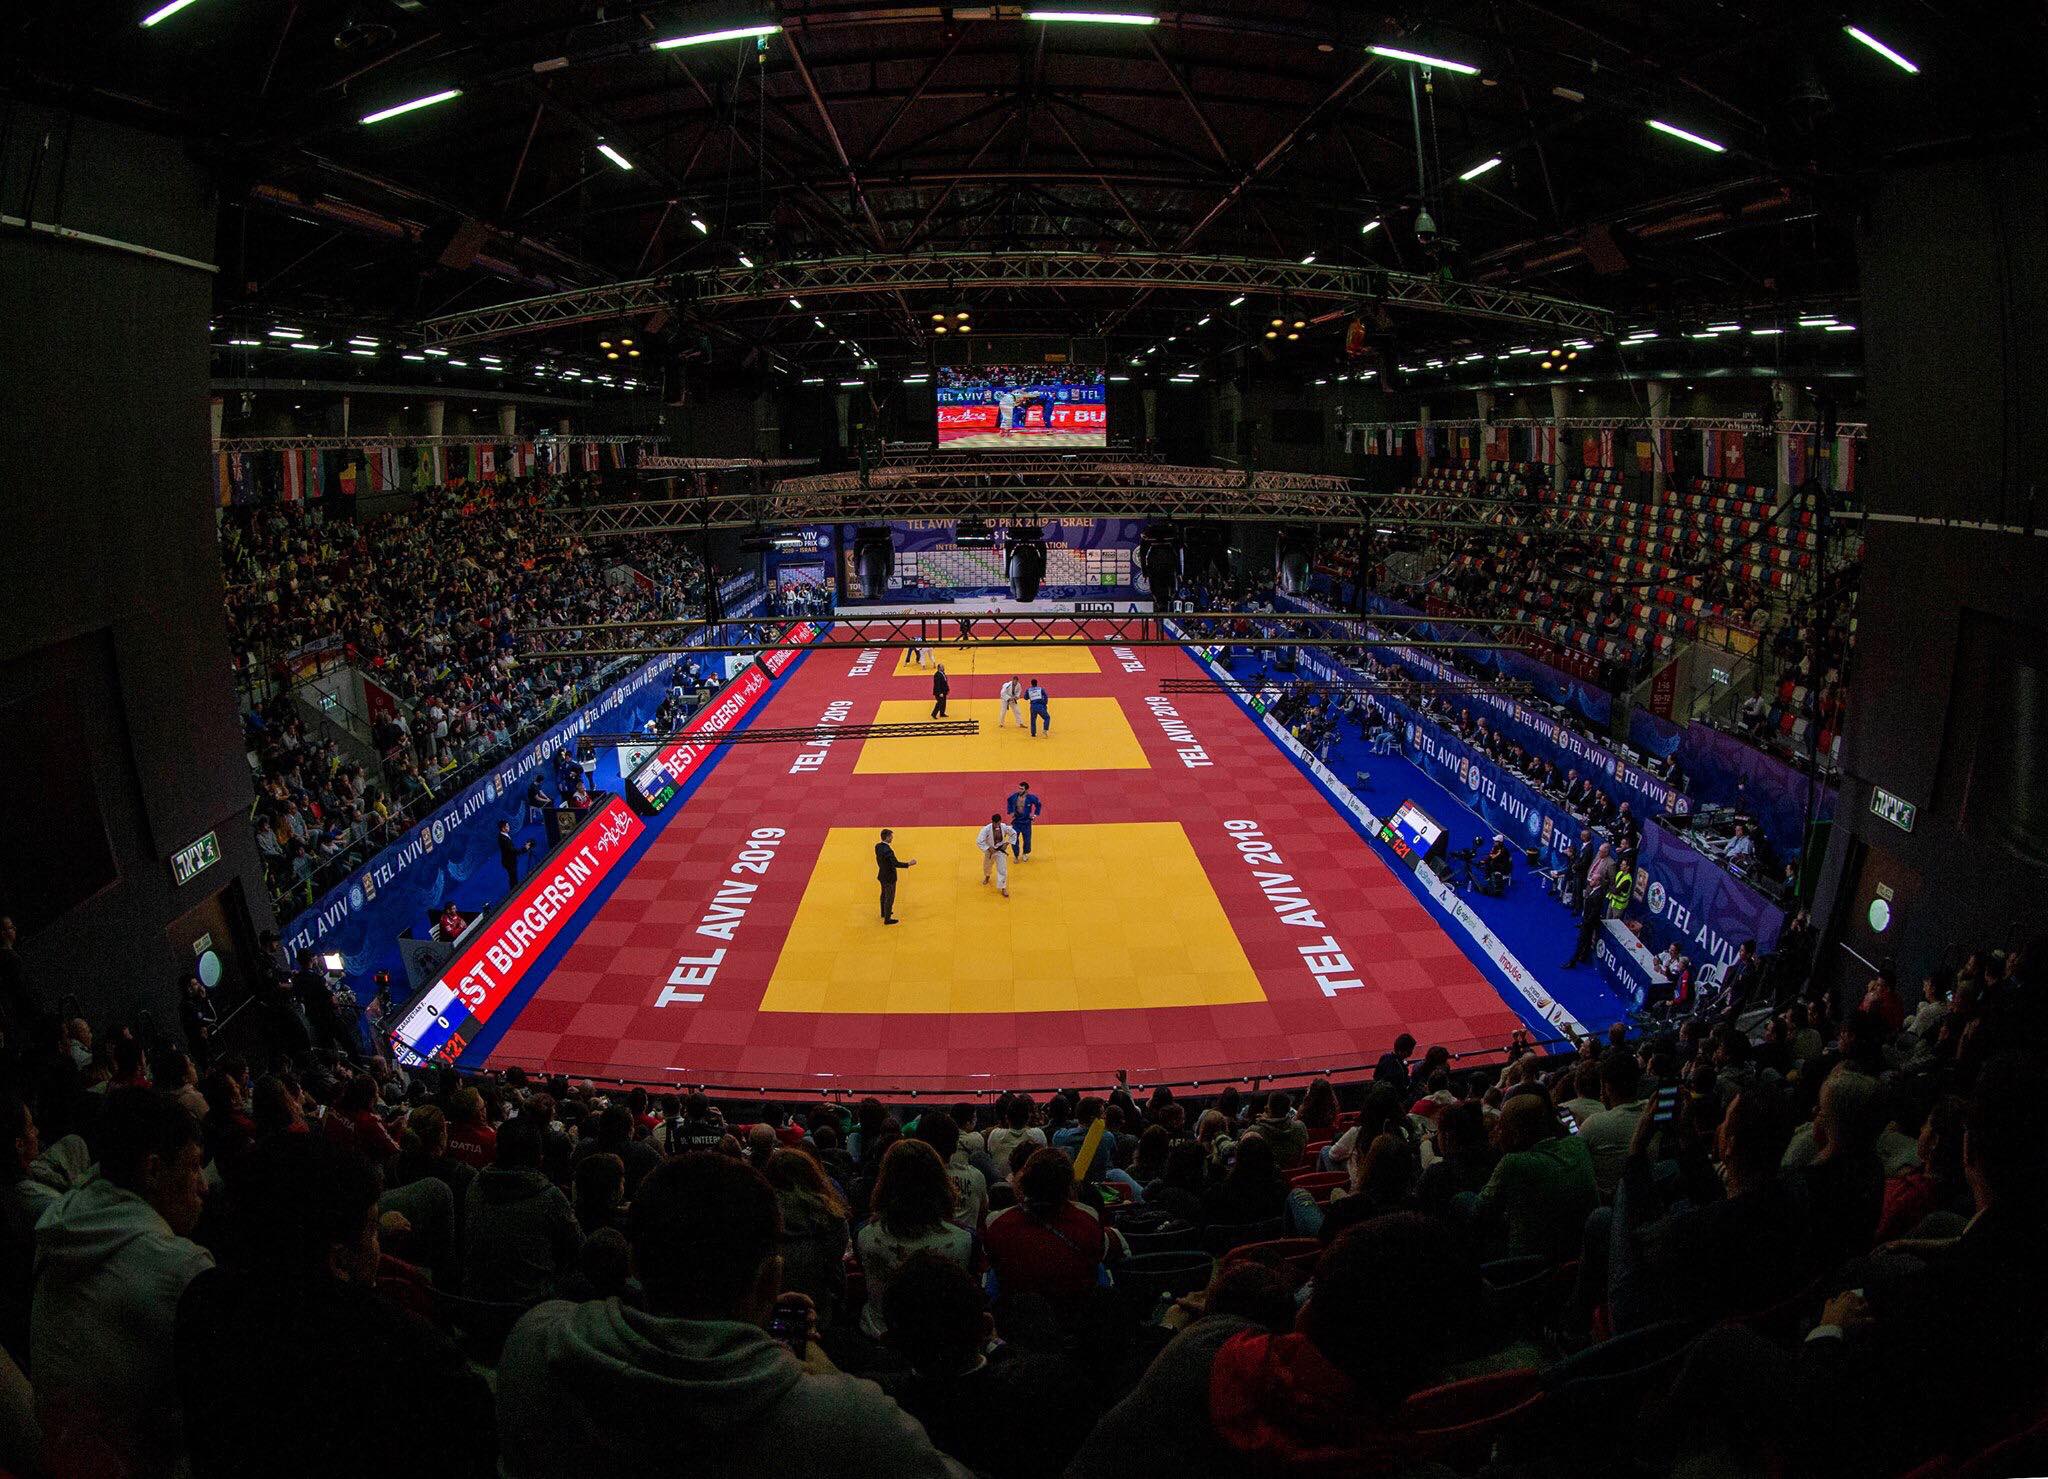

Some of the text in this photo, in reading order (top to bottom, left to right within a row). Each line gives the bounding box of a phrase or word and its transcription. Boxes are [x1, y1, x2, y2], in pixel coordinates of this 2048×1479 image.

[957, 392, 983, 401] AVIV
[1079, 390, 1100, 400] TEL
[908, 519, 925, 530] TEL
[928, 518, 954, 530] AVIV
[1060, 517, 1095, 528] ISRAEL
[550, 721, 579, 752] TEL AVIV
[788, 750, 828, 774] TEL
[820, 700, 854, 722] 2019
[1143, 695, 1215, 769] TEL AVIV 2019
[1520, 710, 1554, 738] TEL AVIV
[502, 752, 537, 788] TEL AVIV
[663, 743, 698, 779] BEST
[1421, 733, 1461, 774] TEL AVIV
[1569, 737, 1606, 769] TEL AVIV
[1481, 775, 1529, 824] TEL AVIV
[1623, 769, 1668, 805] TEL AVIV
[444, 790, 486, 832] TEL AVIV
[373, 839, 424, 889] TEL AVIV
[485, 874, 576, 976] BURGERS
[564, 862, 593, 888] IN
[580, 845, 600, 867] T
[653, 827, 786, 1008] TEL AVIV 2019
[1223, 818, 1366, 998] TEL AVIV 2019
[288, 896, 348, 959] TEL AVIV
[1666, 896, 1742, 967] TEL AVIV
[1498, 951, 1522, 982] impulse
[1604, 948, 1638, 995] TEL AVIV
[427, 1004, 439, 1016] 0
[437, 1016, 450, 1029] 0
